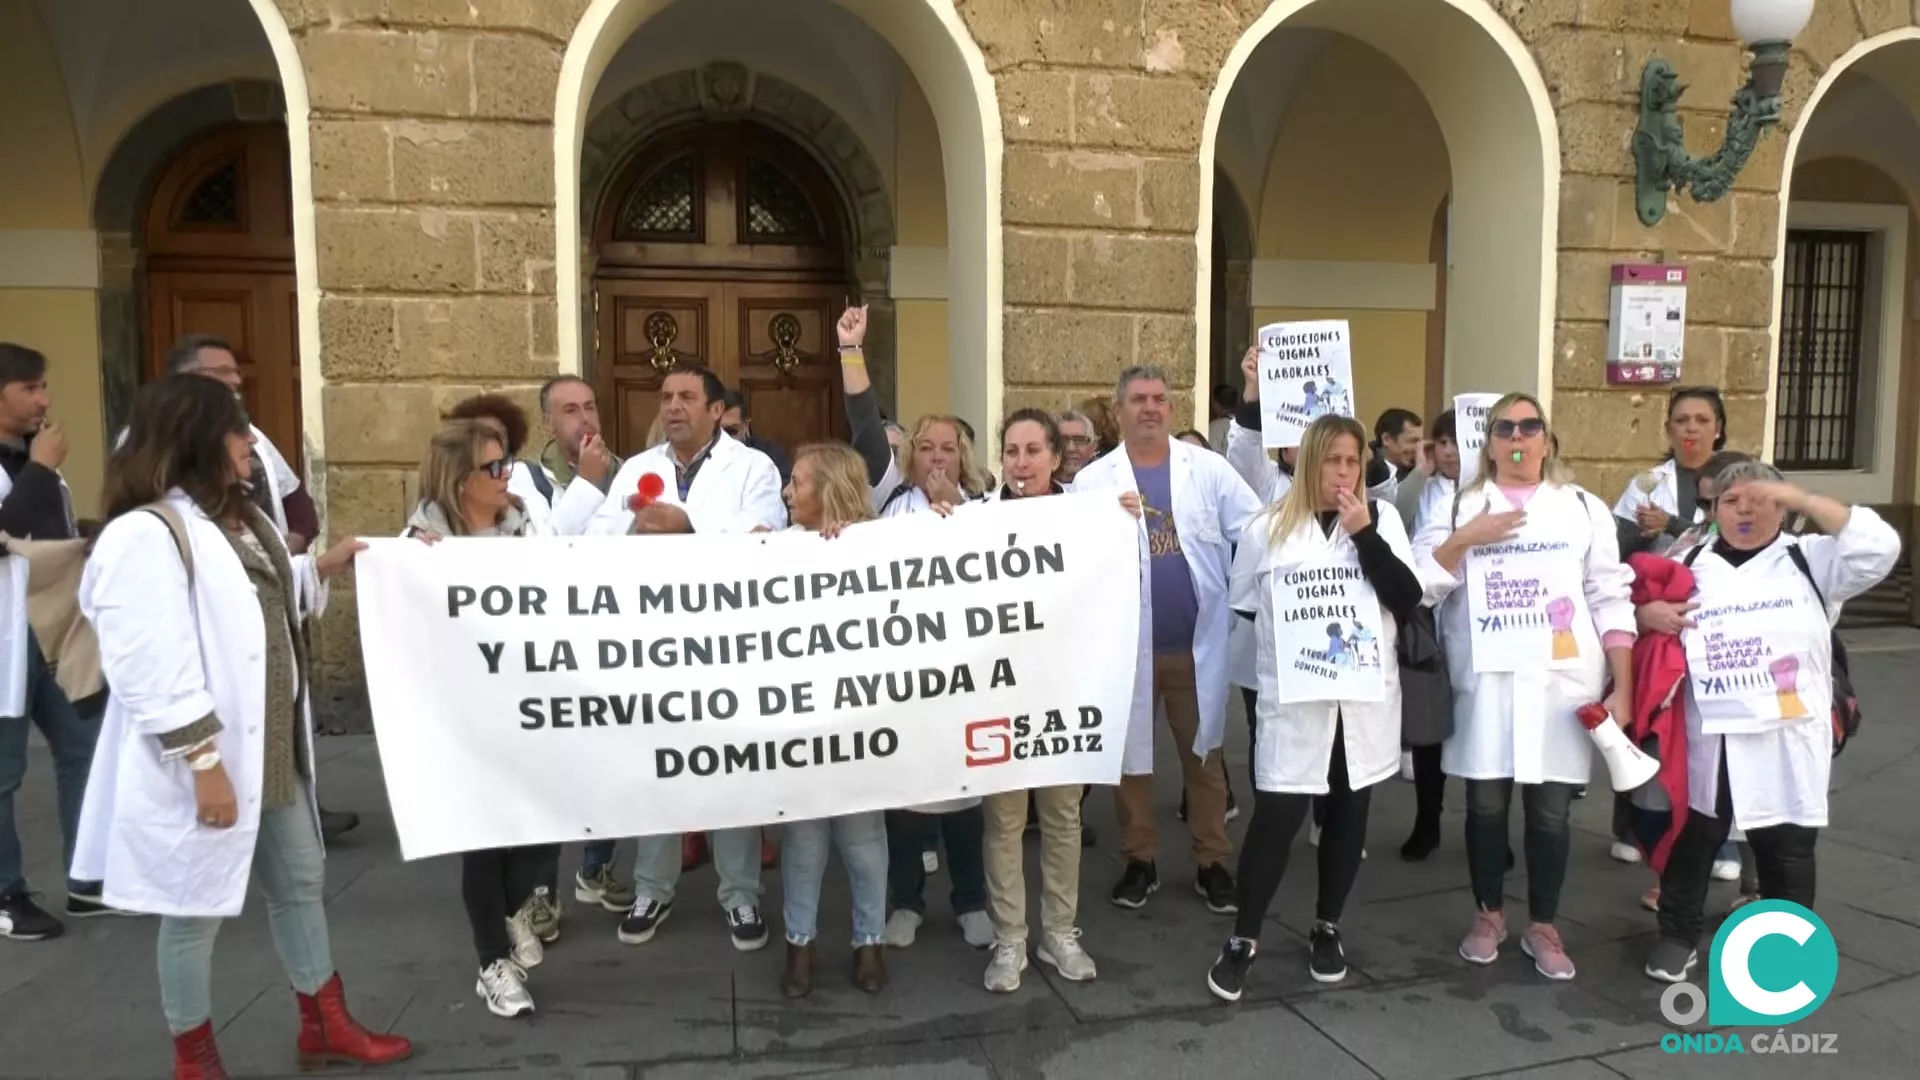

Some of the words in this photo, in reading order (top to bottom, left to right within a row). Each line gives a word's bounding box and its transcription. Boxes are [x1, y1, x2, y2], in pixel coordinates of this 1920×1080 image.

[1267, 365, 1330, 380] LABORALES
[448, 584, 548, 618] POR
[568, 584, 621, 616] LA
[639, 533, 1065, 614] MUNICIPALIZACIÓN
[1284, 604, 1357, 622] LABORALES
[477, 641, 506, 674] Y
[525, 639, 579, 673] LA
[598, 599, 947, 670] DIGNIFICACIÓN
[965, 600, 1044, 638] DEL
[1294, 660, 1338, 680] DOMICILIO
[519, 688, 740, 730] SERVICIO
[758, 681, 815, 717] DE
[834, 663, 976, 710] AYUDA
[990, 657, 1017, 689] A
[655, 727, 899, 778] DOMICILIO
[1014, 734, 1103, 760] CÁDIZ
